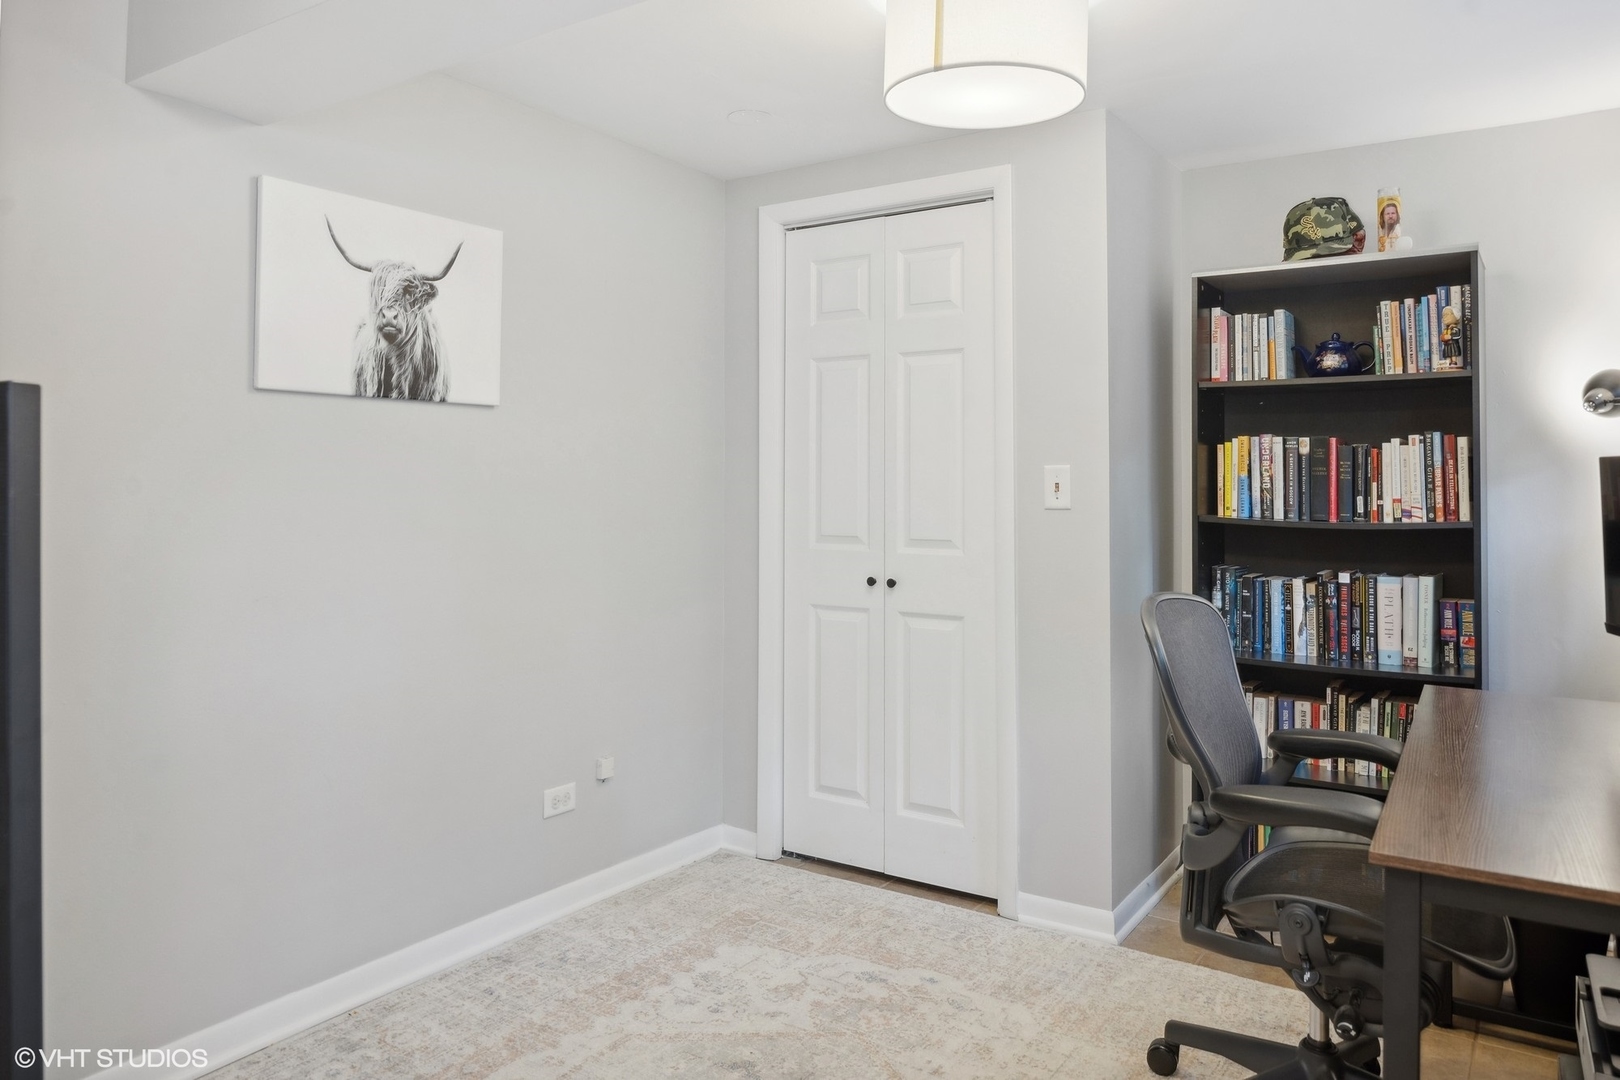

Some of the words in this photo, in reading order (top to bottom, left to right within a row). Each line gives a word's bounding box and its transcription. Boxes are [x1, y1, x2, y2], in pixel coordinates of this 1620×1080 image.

[1383, 303, 1391, 333] TRUE
[1262, 437, 1270, 489] UNDERLAND
[1384, 596, 1394, 636] PLATH
[1444, 609, 1452, 618] ANN
[1462, 610, 1473, 622] ANN
[1444, 619, 1452, 628] RULE
[1462, 622, 1474, 636] RULE
